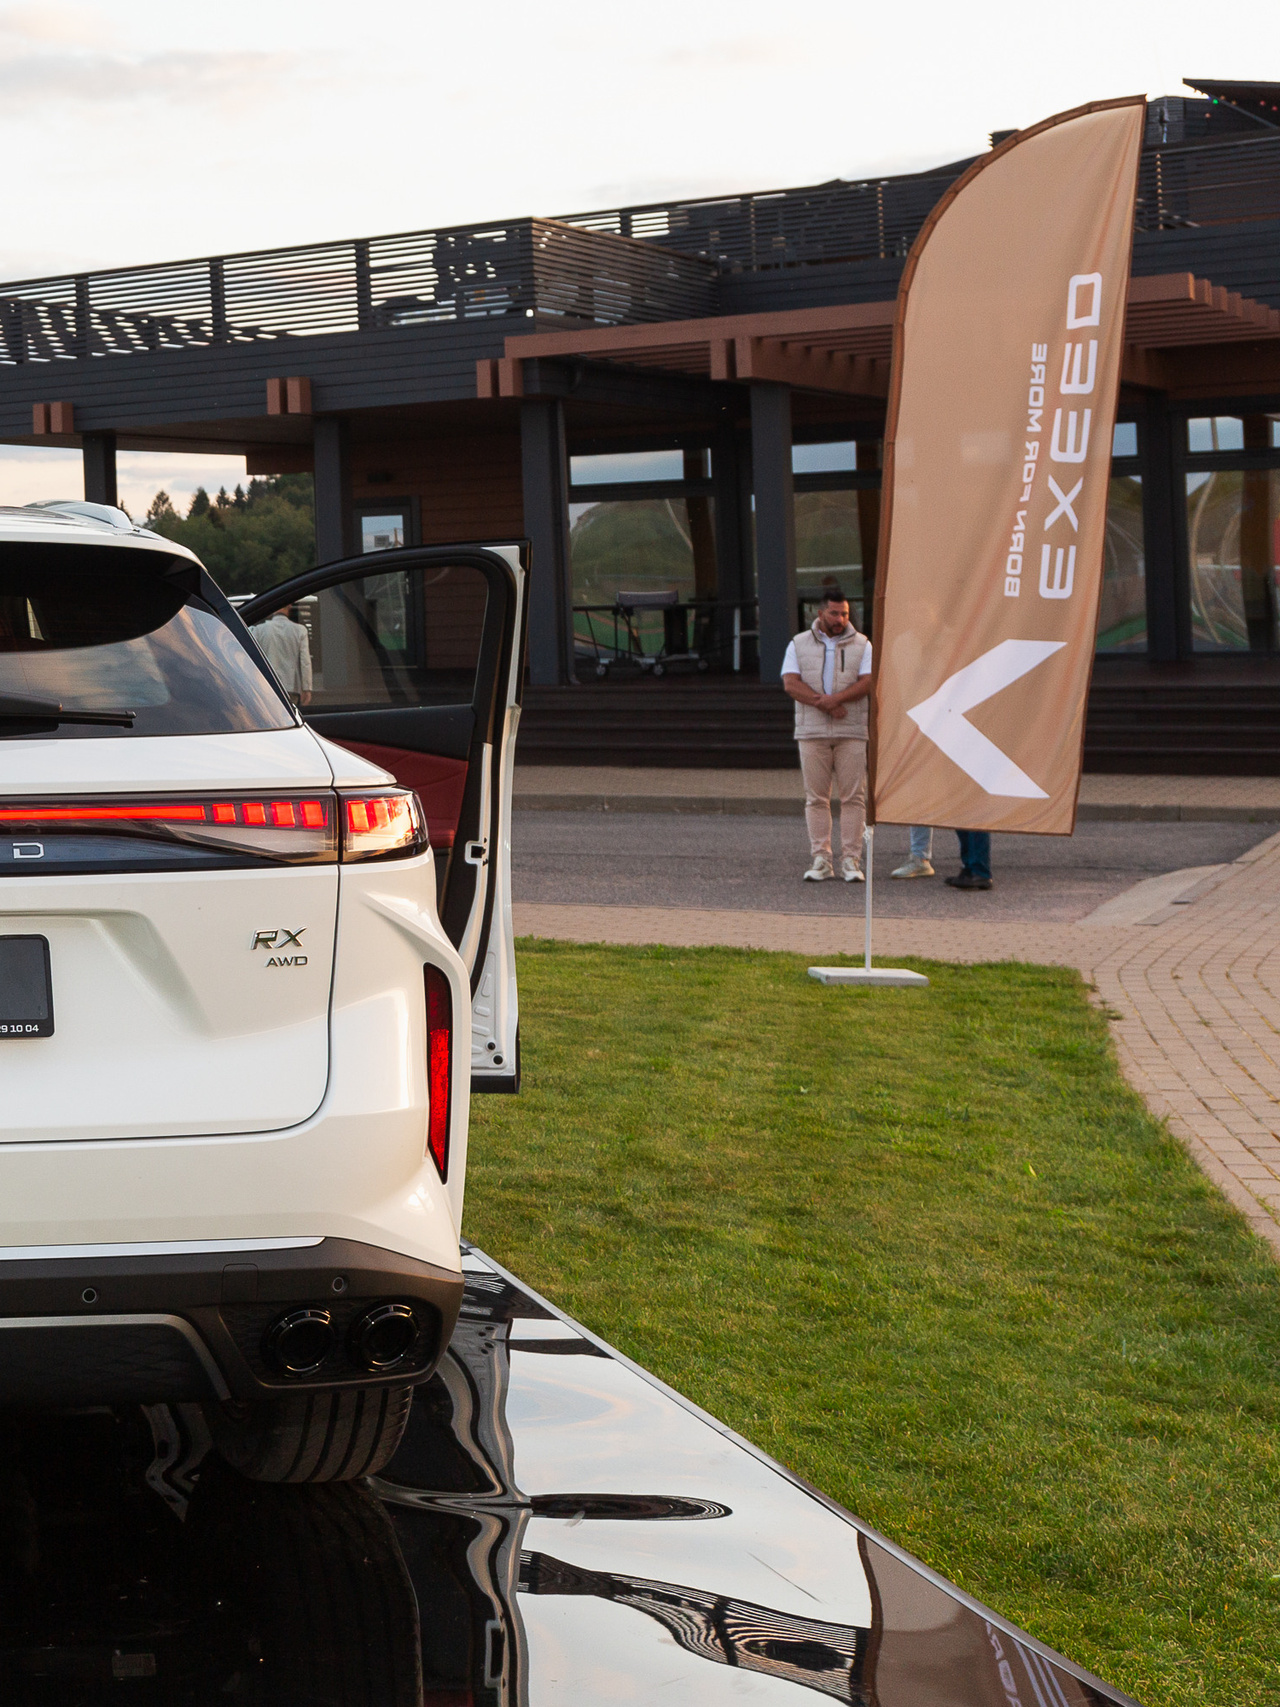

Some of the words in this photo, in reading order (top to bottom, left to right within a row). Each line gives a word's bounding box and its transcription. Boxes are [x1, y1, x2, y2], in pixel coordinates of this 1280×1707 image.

[250, 926, 307, 950] RX
[264, 955, 308, 967] AWD
[10, 1024, 23, 1033] 10
[25, 1024, 39, 1033] 04
